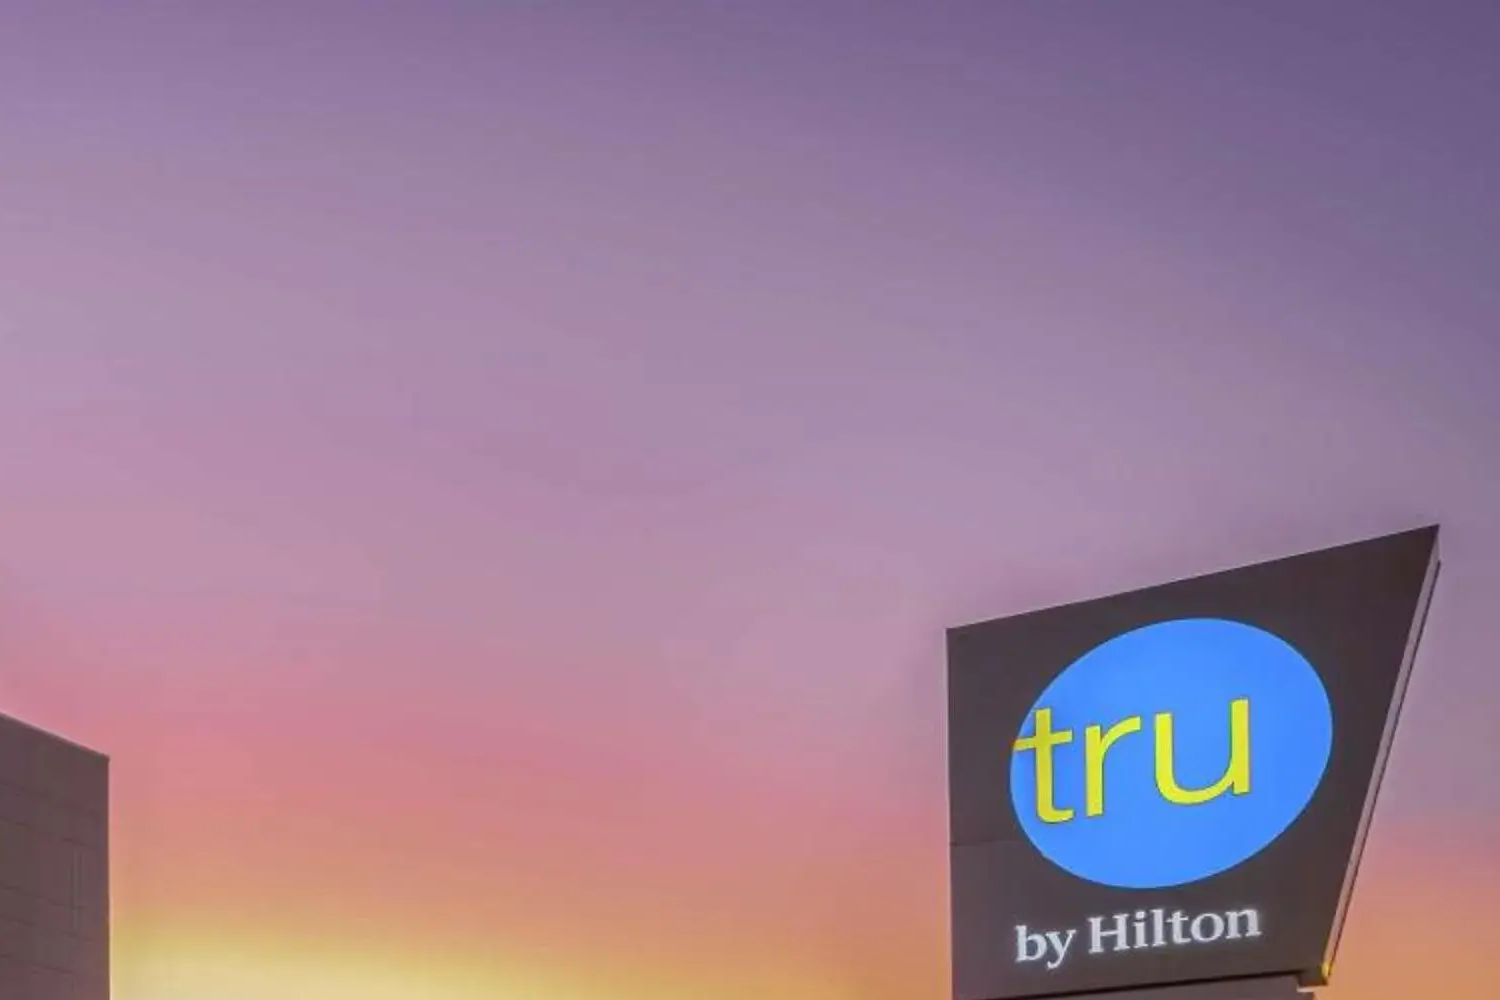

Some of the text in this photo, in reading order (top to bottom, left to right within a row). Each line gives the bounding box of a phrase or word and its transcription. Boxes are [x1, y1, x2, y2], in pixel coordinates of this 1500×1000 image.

[1013, 698, 1251, 824] tru
[1015, 908, 1263, 970] by Hilton
